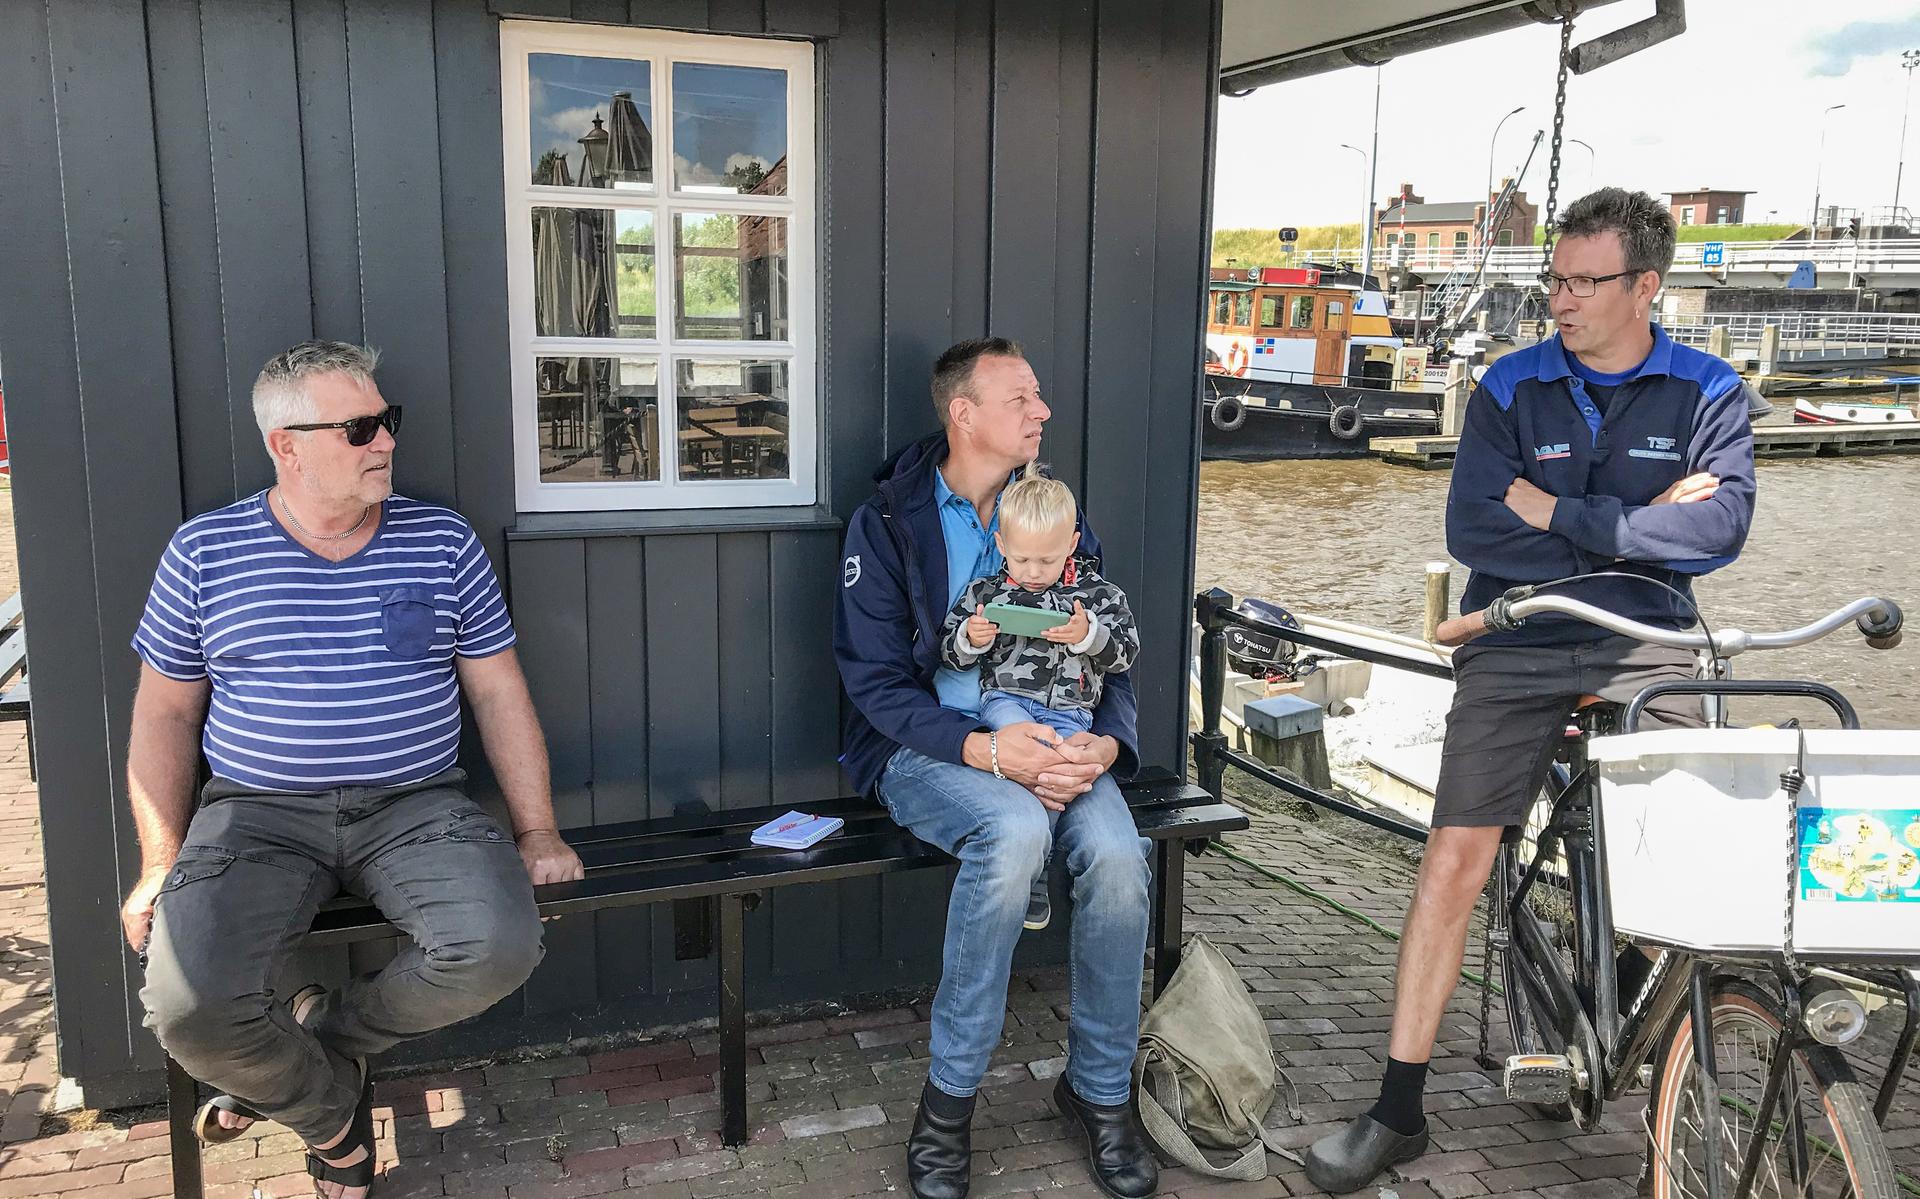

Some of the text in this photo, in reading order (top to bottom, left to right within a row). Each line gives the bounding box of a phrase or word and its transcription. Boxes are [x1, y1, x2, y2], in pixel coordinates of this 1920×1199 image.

[1705, 244, 1723, 252] VHF
[1243, 638, 1271, 654] TOHATSU
[1631, 949, 1668, 1017] Gazell
